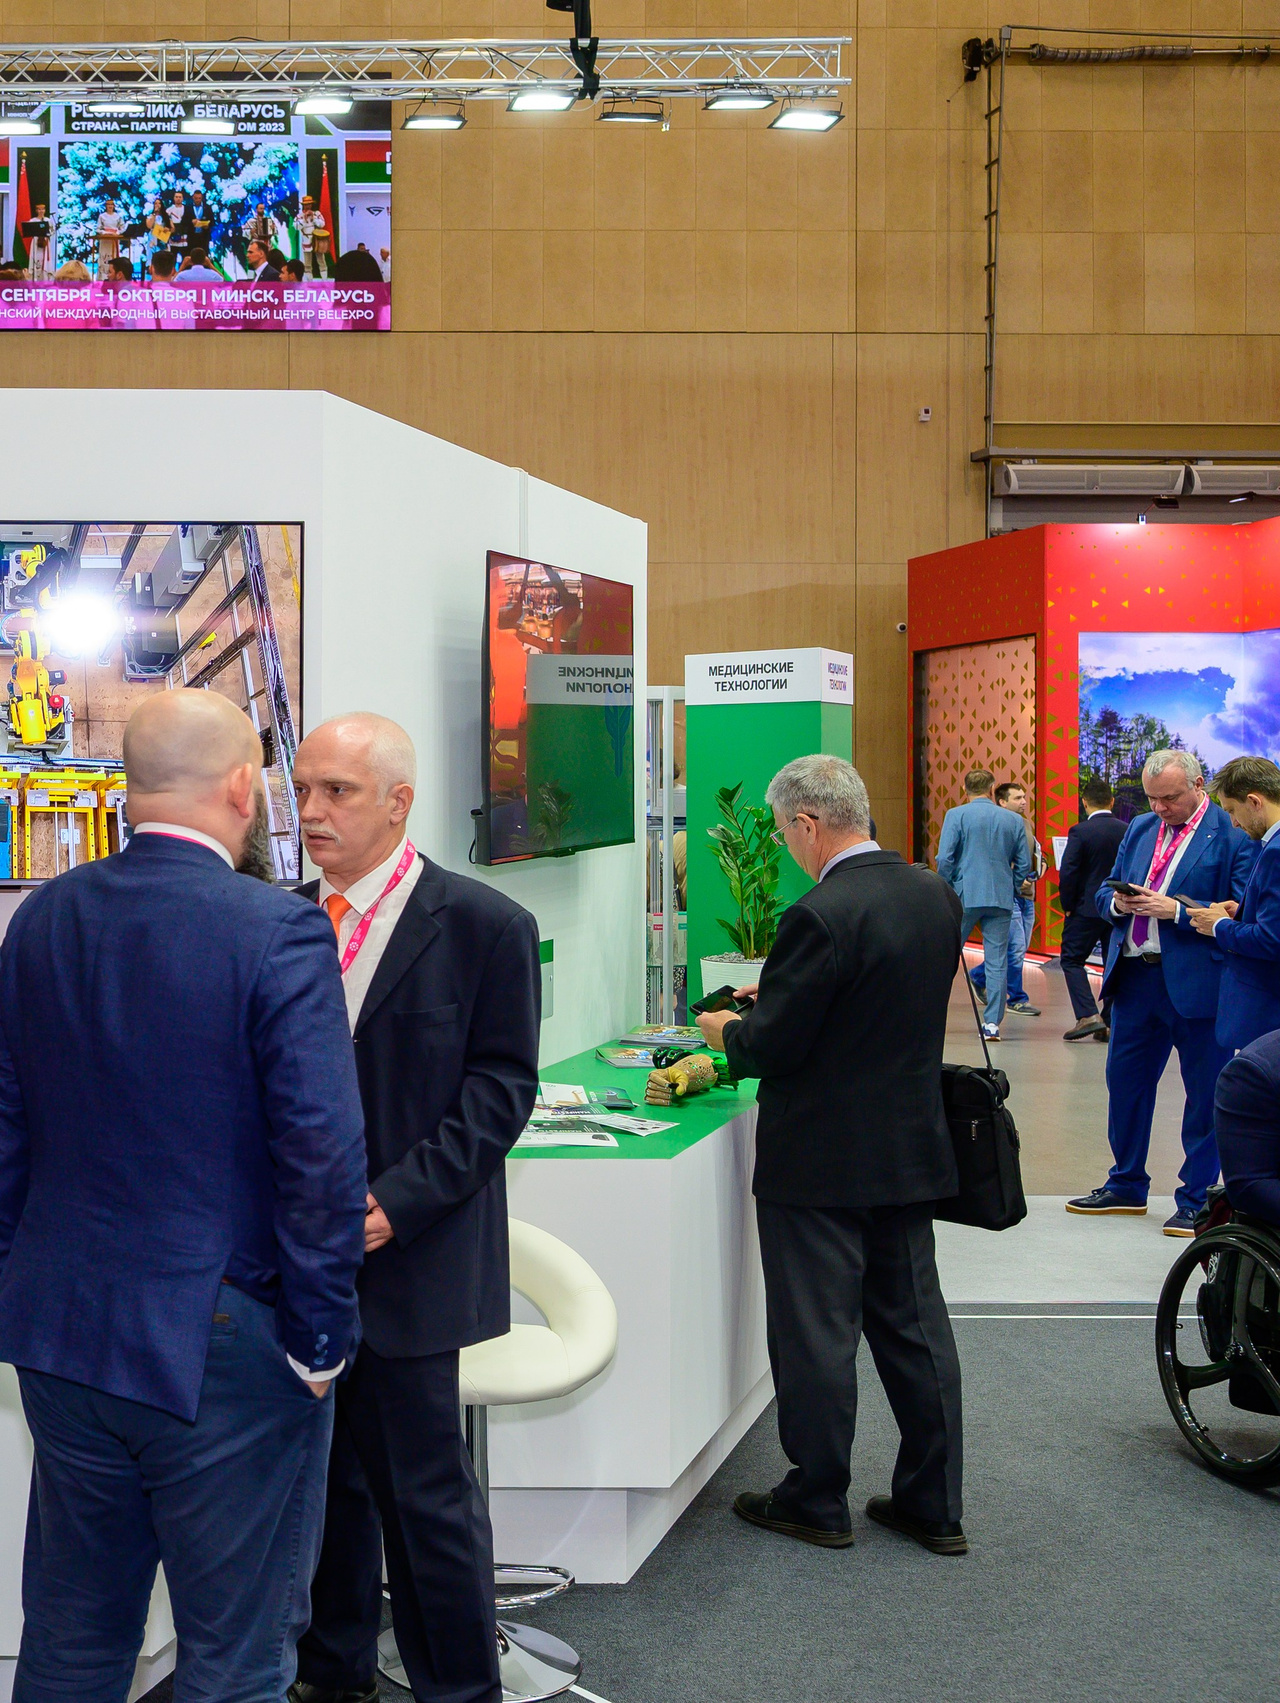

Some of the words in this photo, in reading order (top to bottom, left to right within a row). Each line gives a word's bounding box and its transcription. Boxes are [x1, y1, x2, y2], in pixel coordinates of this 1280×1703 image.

[194, 104, 285, 118] БЕЛАРУСЬ
[71, 122, 119, 131] СТРАНА
[131, 120, 178, 132] ПАРТНЁ
[258, 122, 285, 132] 2023
[1, 289, 91, 302] СЕНТЯБРЯ
[108, 290, 114, 302] 1
[118, 289, 197, 302] ОКТЯБРЯ
[211, 290, 279, 305] МИНСК,
[283, 290, 375, 303] БЕЛАРУСЬ
[45, 307, 167, 320] МЕЖДУНАРОДНЫЙ
[170, 308, 270, 320] ВЫСТАВОЧНЫЙ
[273, 309, 315, 321] ЦЕНТР
[318, 309, 375, 320] BELEXPO
[708, 662, 795, 678] МЕДИЦИНСКИЕ
[715, 679, 788, 692] ТЕХНОЛОГИИ
